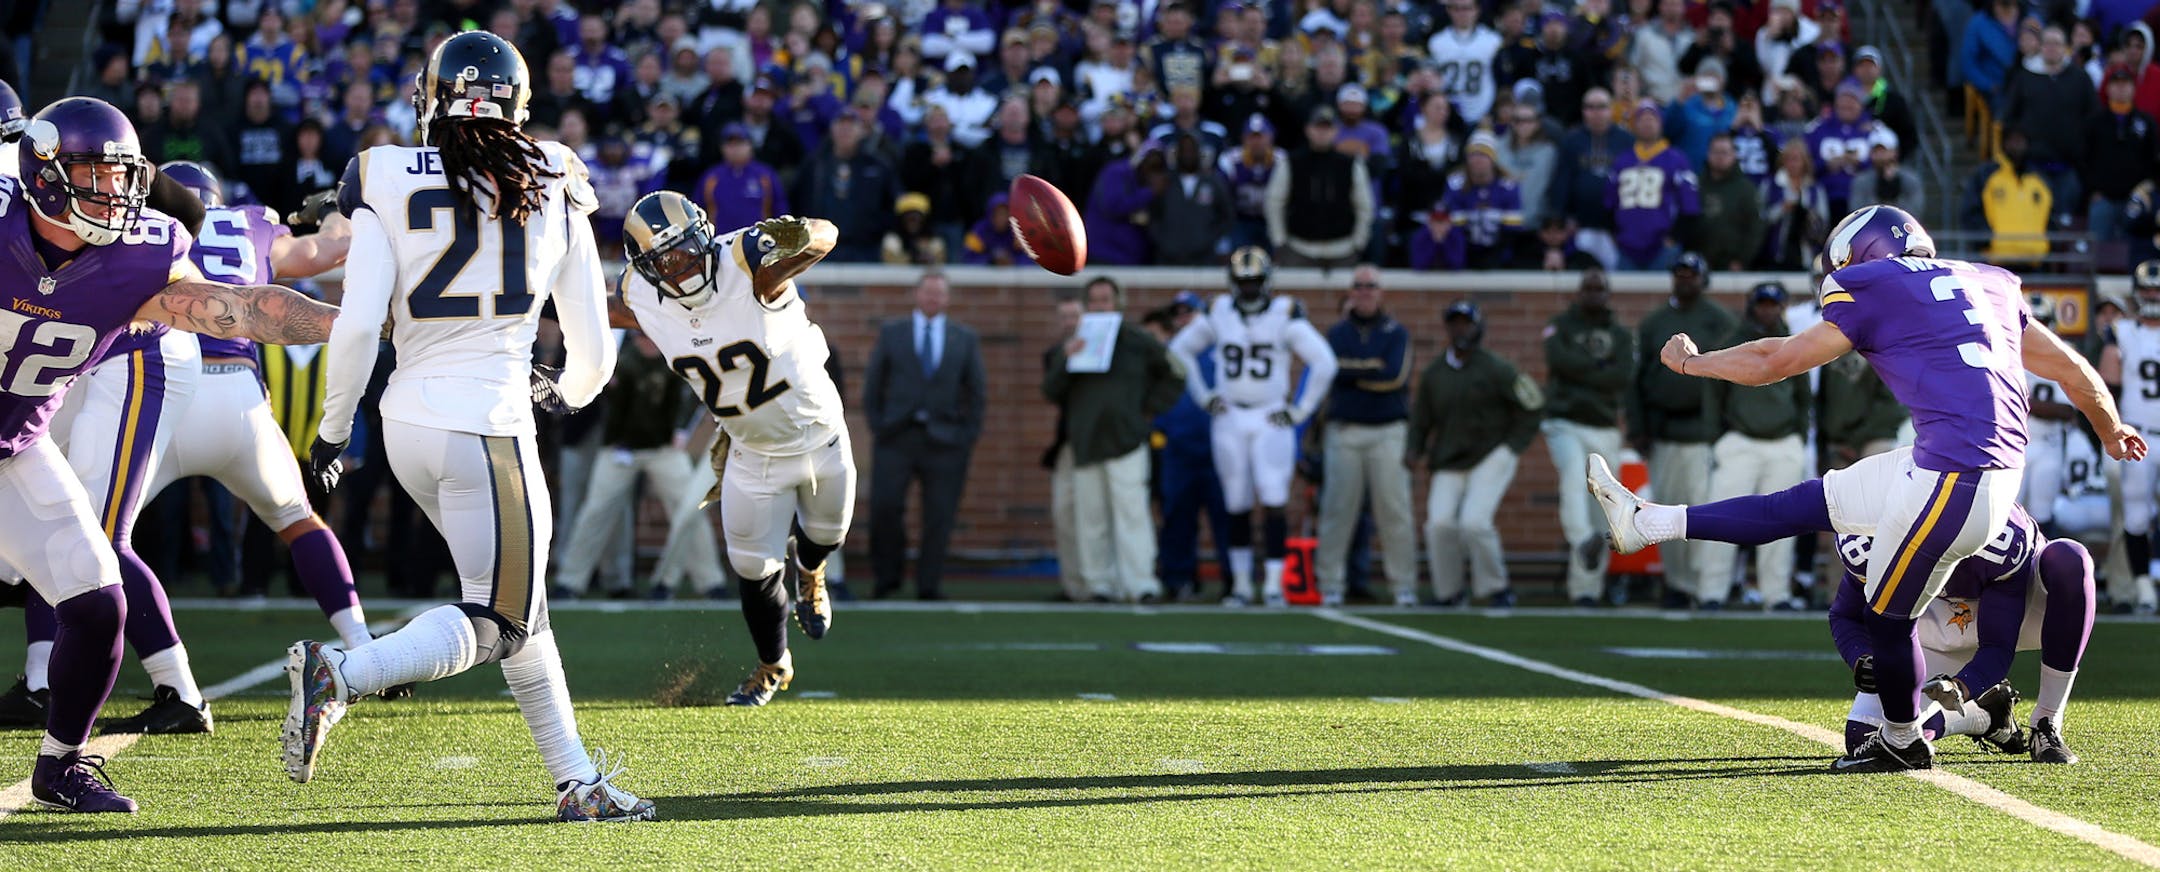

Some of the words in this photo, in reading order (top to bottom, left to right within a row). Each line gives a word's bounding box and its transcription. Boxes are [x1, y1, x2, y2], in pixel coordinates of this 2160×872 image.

[1440, 61, 1482, 95] 28
[1618, 165, 1665, 209] 28
[405, 185, 536, 322] 21
[1929, 275, 2010, 370] 3
[672, 339, 792, 417] 22
[1223, 344, 1273, 379] 95
